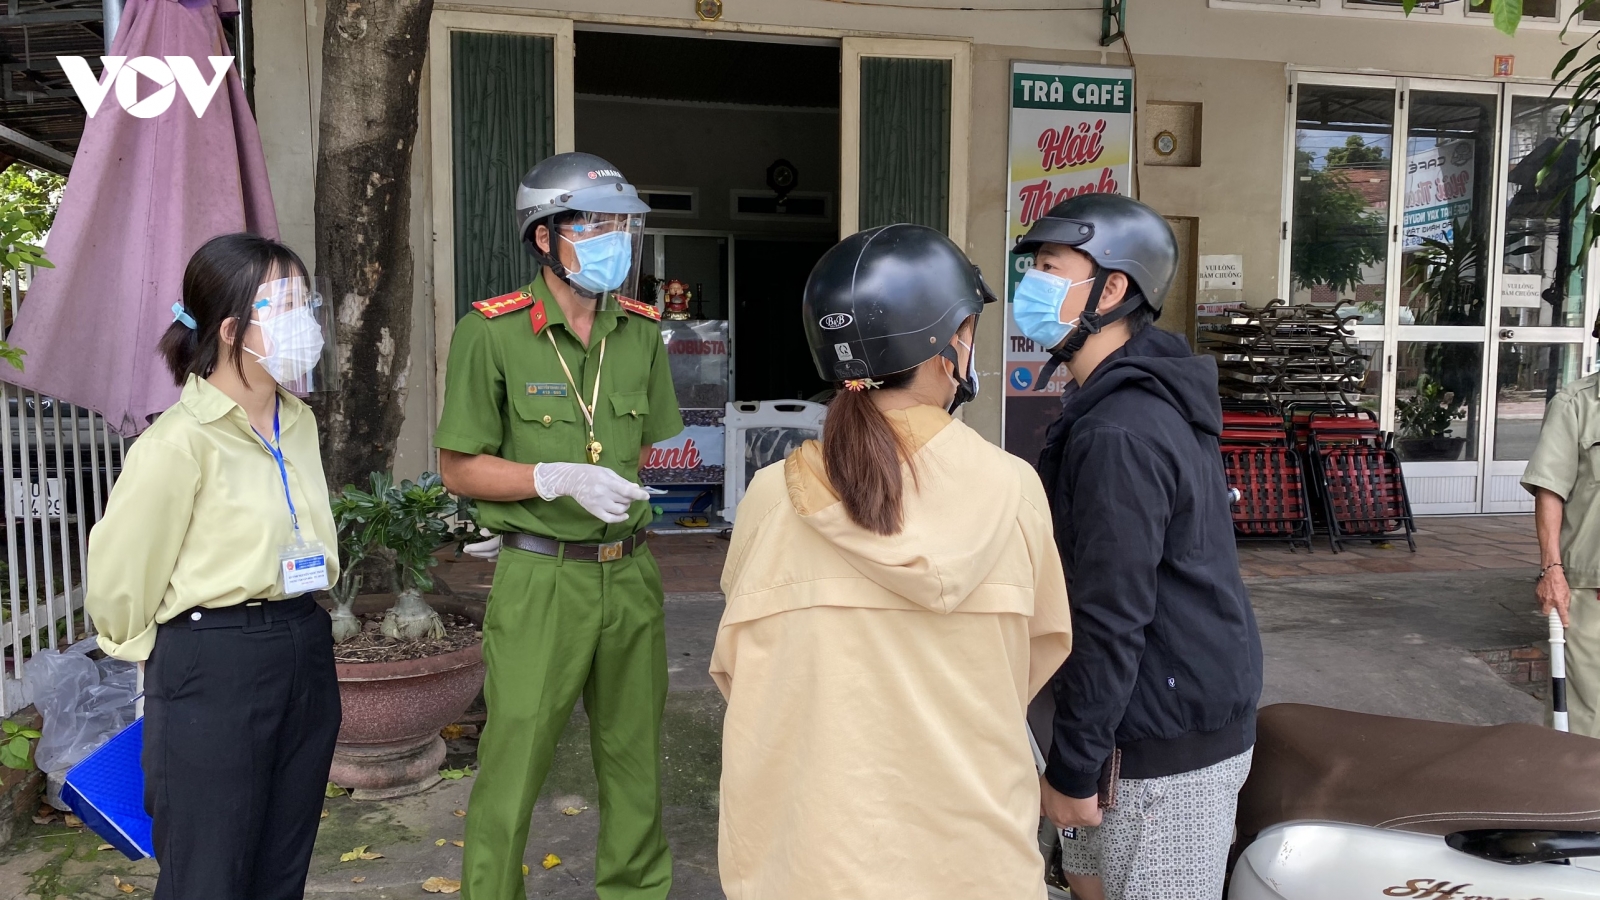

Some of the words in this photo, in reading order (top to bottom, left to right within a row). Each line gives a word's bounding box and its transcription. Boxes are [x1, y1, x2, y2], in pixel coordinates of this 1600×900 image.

[1021, 77, 1063, 103] TRÀ
[1072, 81, 1124, 105] CAFÉ
[1037, 119, 1107, 172] Hải
[595, 169, 623, 179] YAMAHA
[667, 340, 726, 355] ROBUSTA
[645, 437, 703, 470] anh
